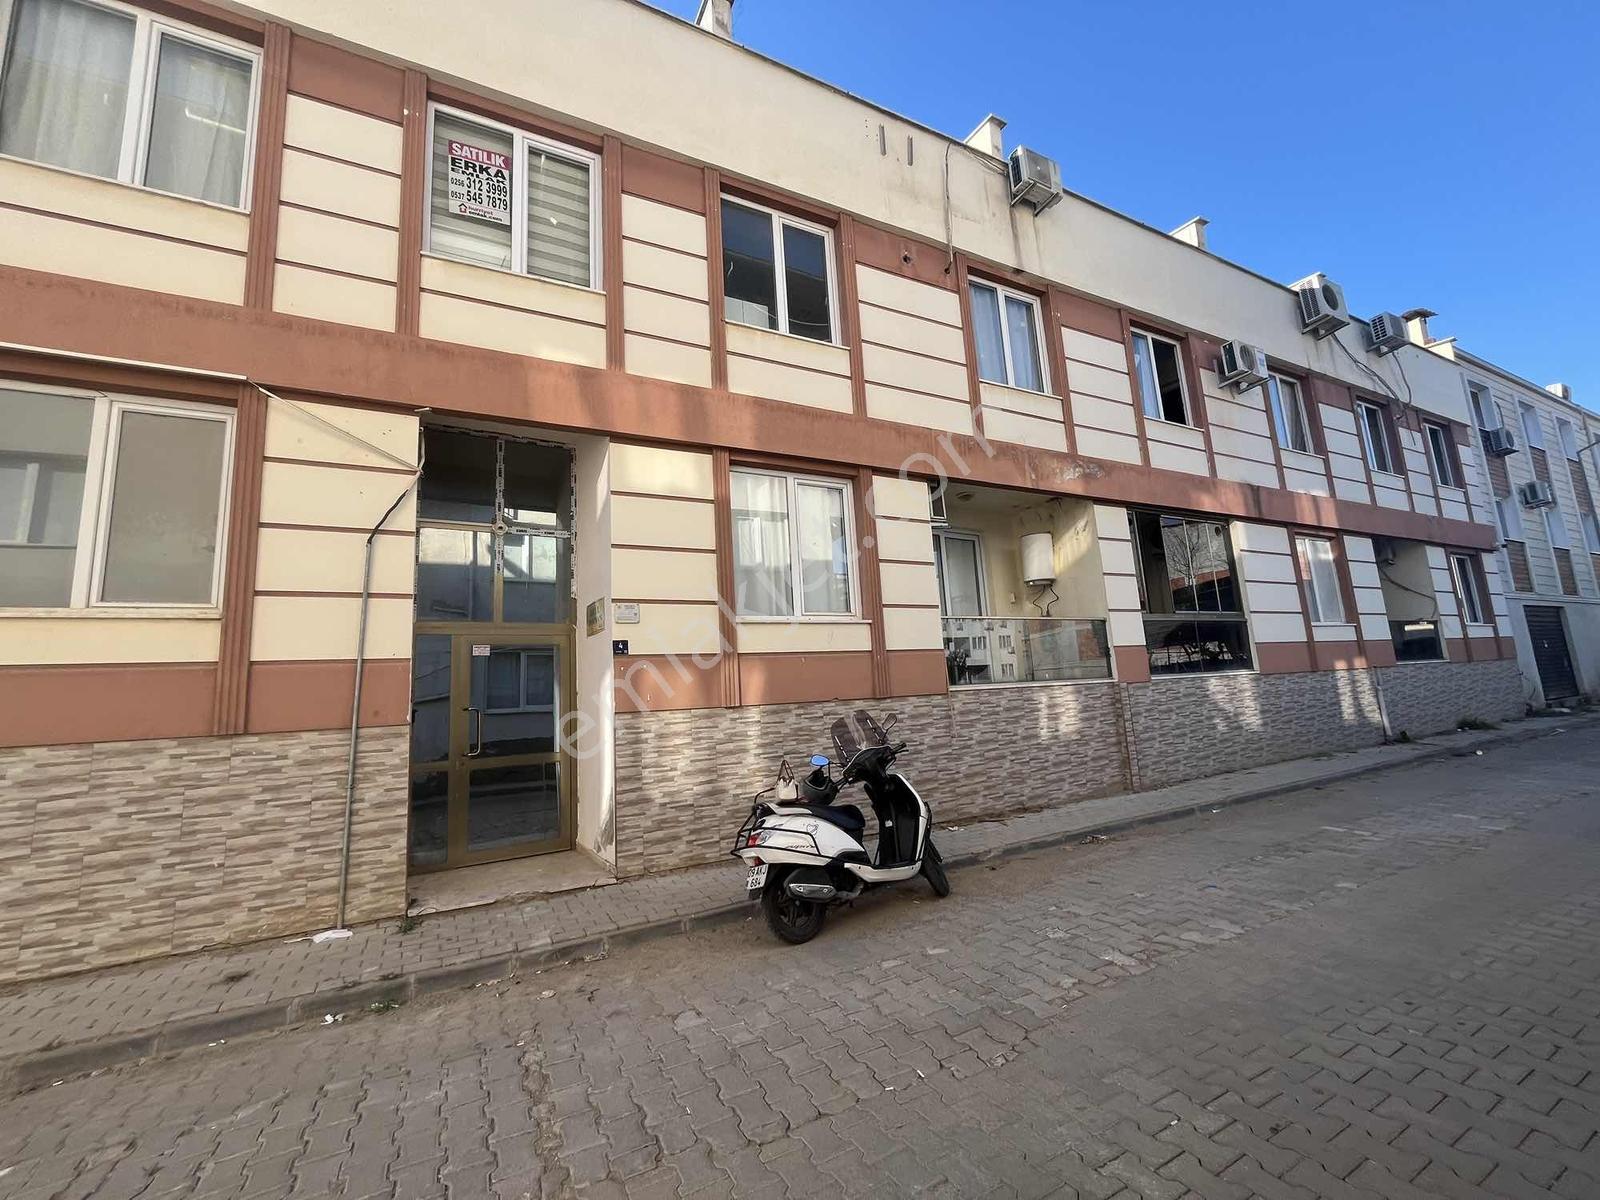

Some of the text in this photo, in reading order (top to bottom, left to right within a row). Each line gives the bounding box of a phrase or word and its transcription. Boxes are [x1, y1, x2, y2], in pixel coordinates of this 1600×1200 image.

[451, 142, 506, 168] SATILIK
[450, 156, 507, 180] ERKA
[450, 177, 508, 198] 0256 312 3999
[450, 190, 508, 211] 0537 545 7879
